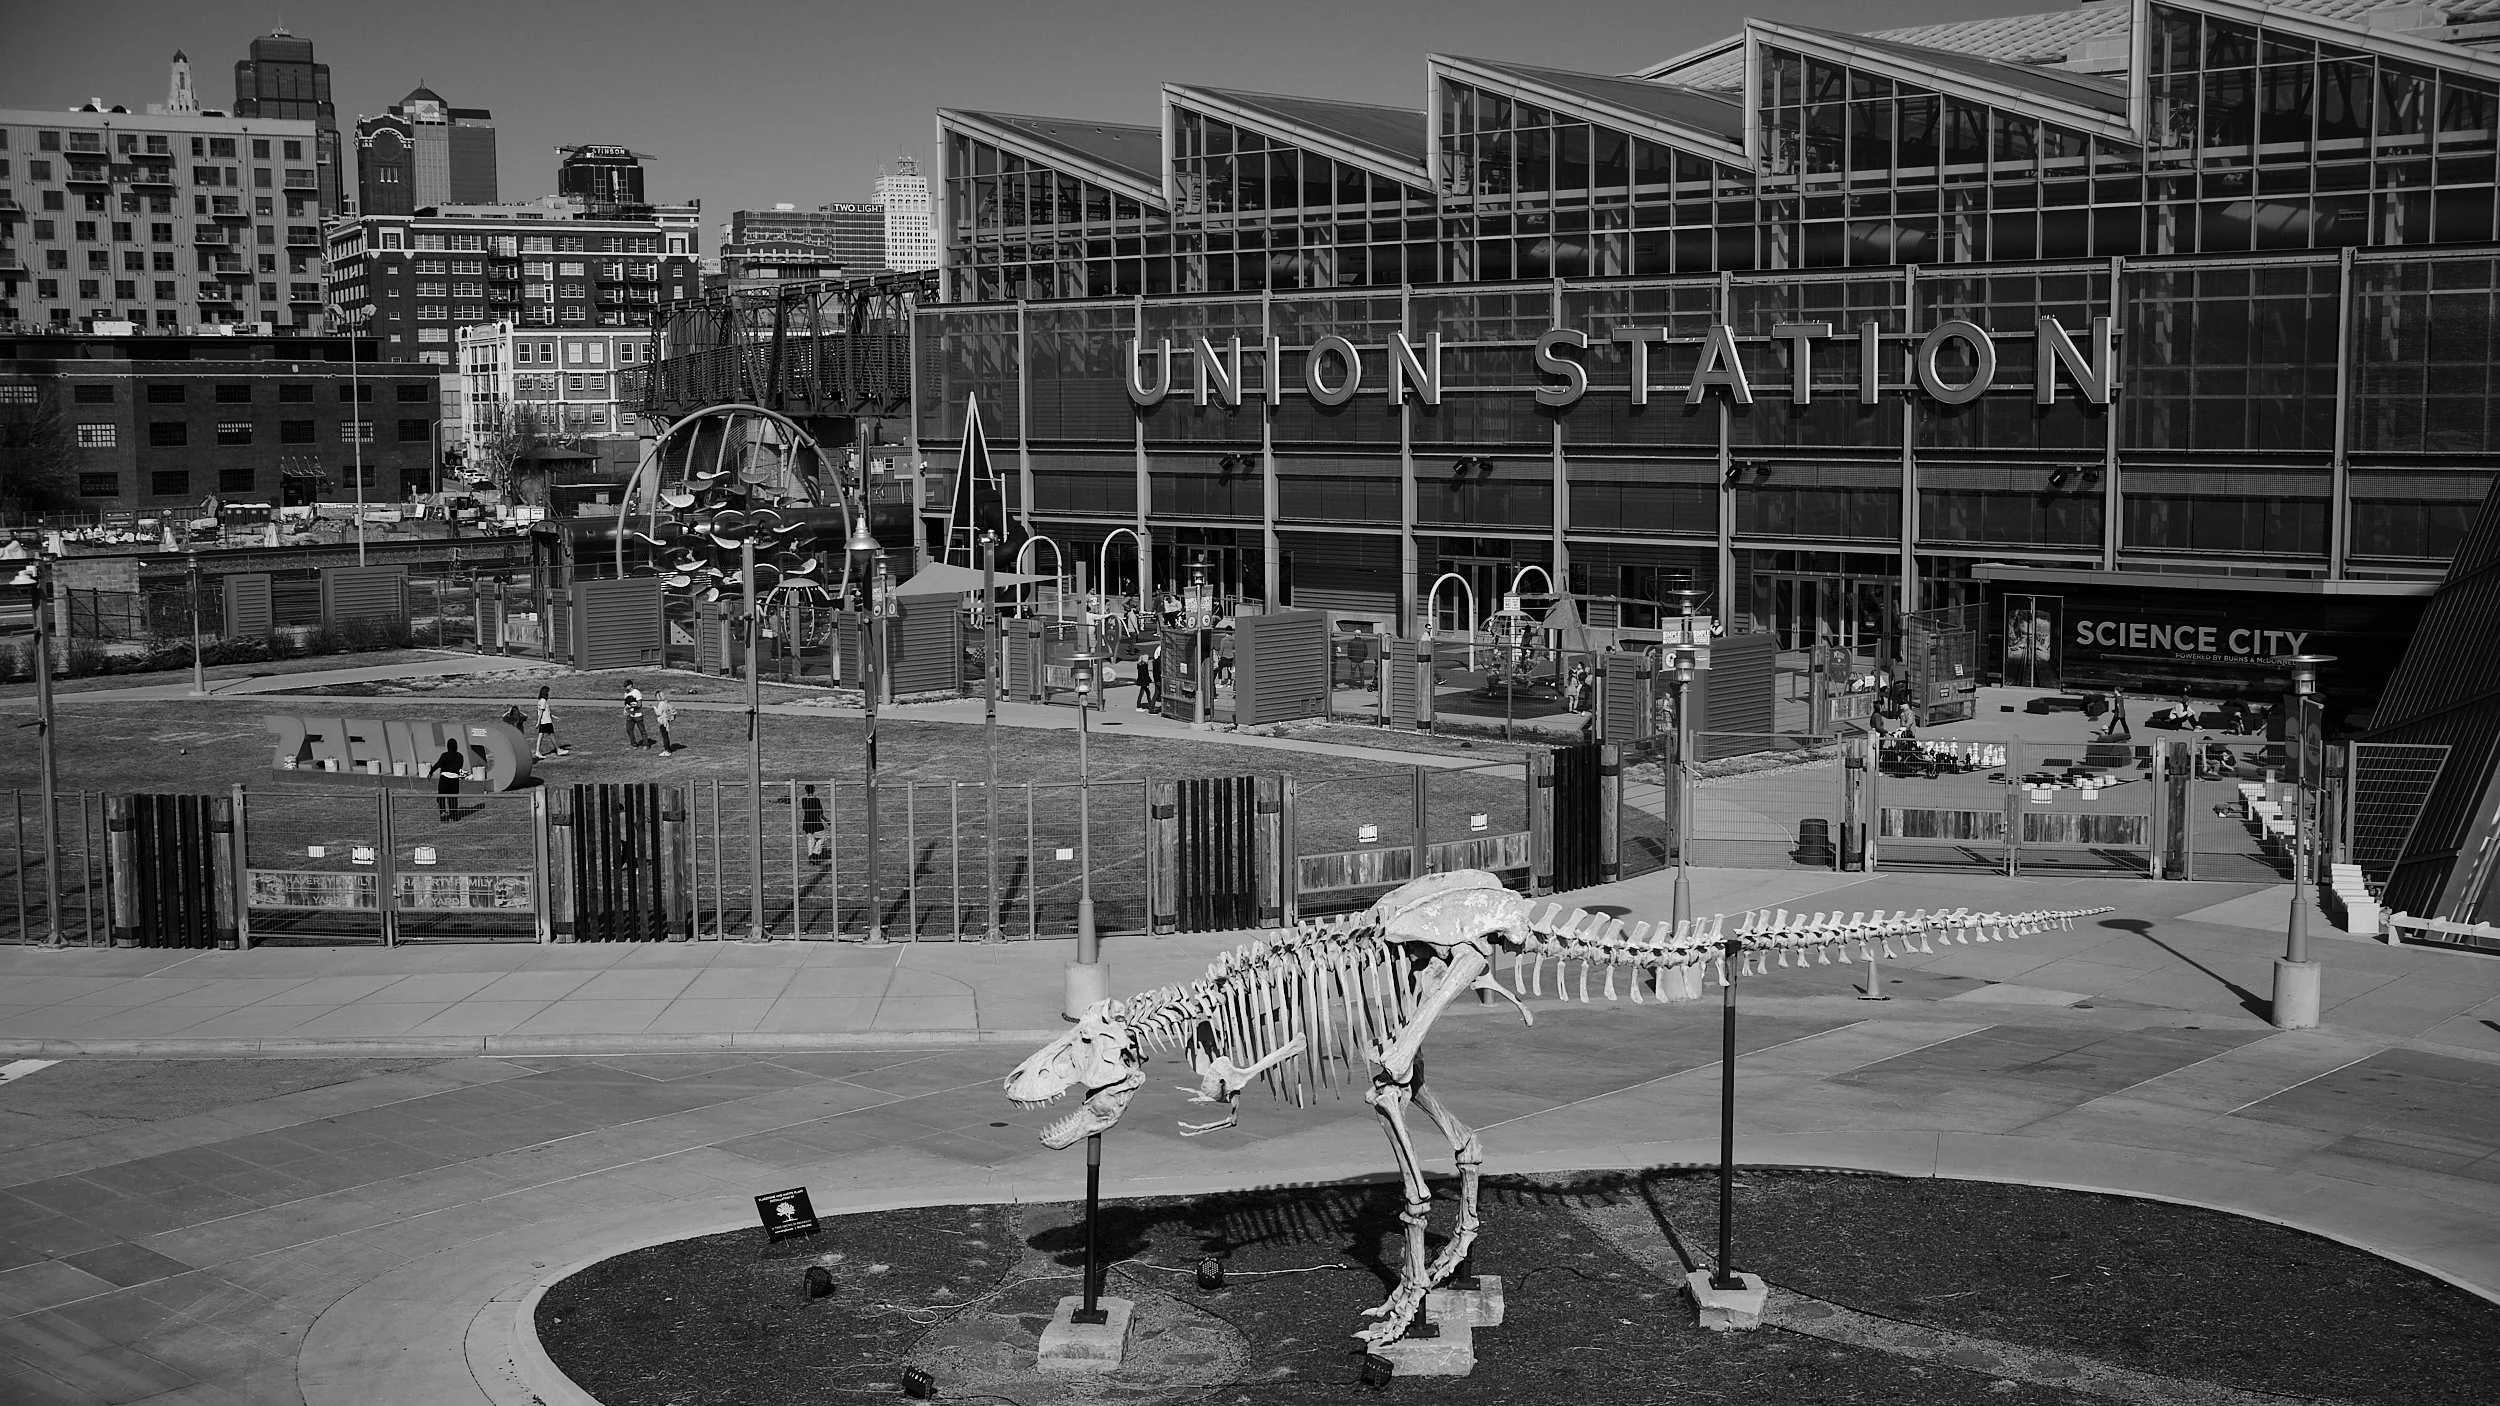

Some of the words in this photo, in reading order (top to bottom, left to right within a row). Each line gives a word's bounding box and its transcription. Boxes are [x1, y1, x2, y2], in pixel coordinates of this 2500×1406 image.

[834, 204, 856, 212] TWO
[857, 204, 884, 213] LIGHT
[1125, 331, 1441, 407] UNION
[1535, 315, 2112, 407] STATION
[2076, 620, 2218, 652] SCIENCE
[2228, 628, 2309, 656] CITY
[2175, 652, 2212, 661] POWERED
